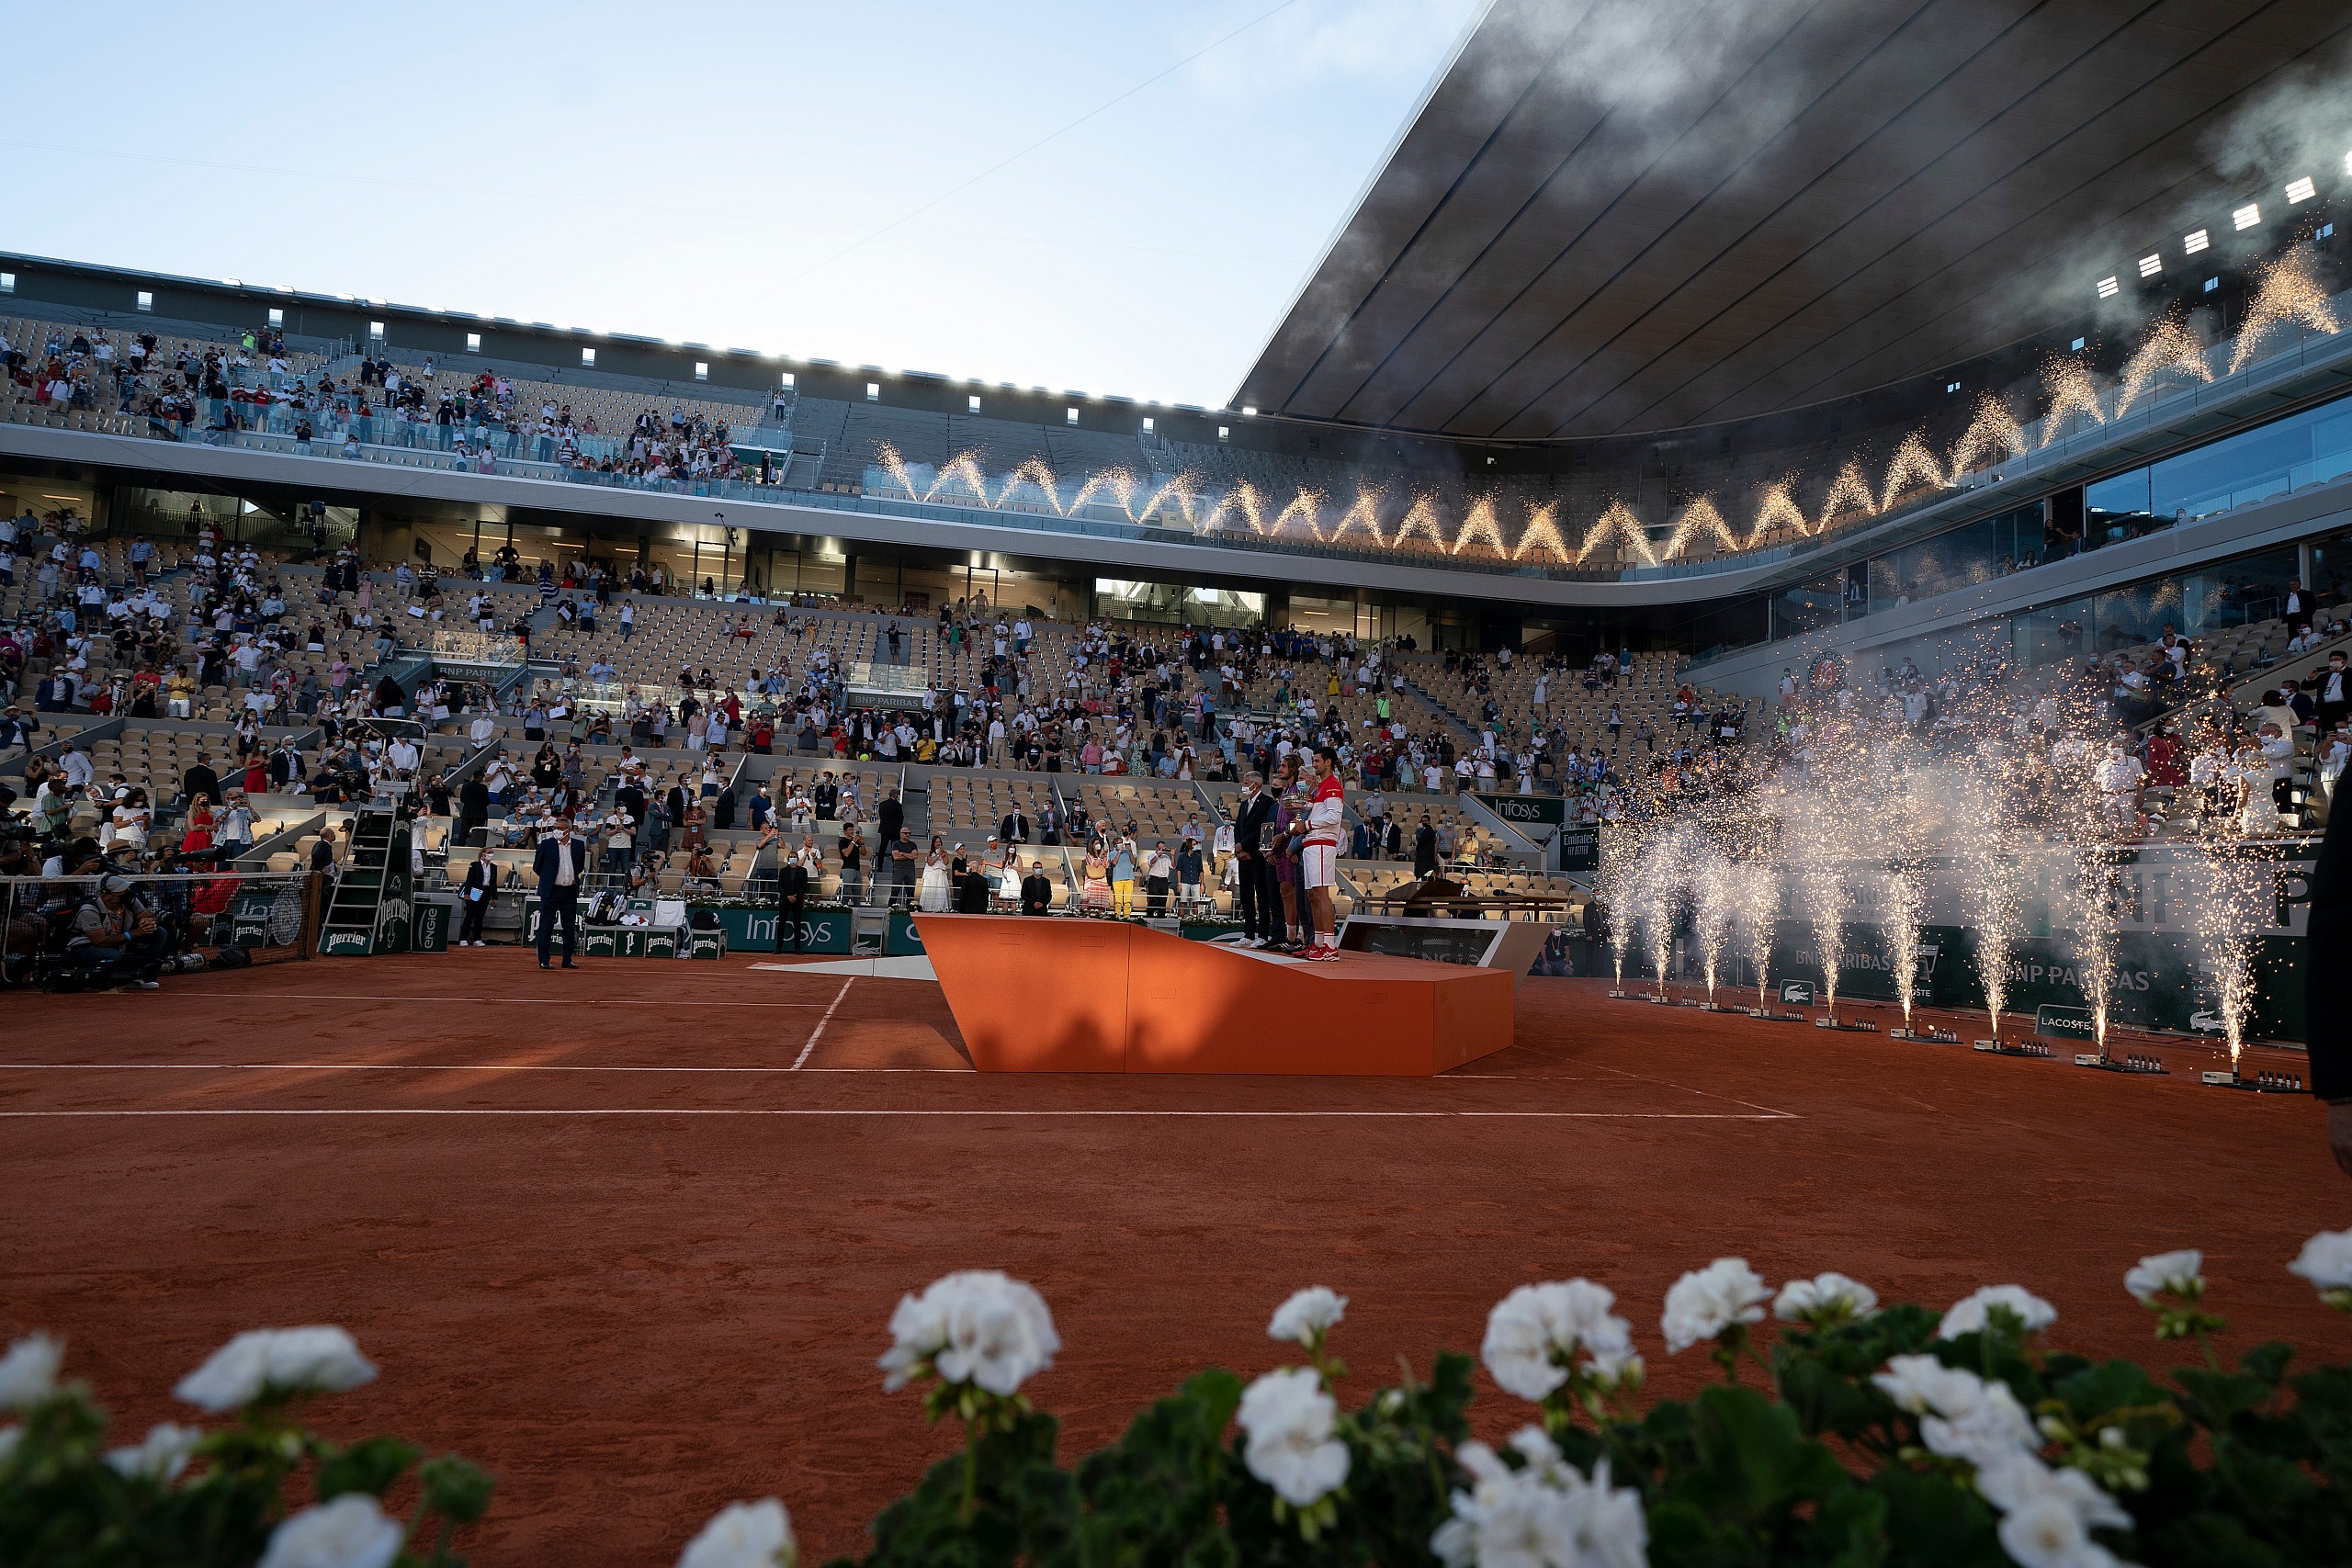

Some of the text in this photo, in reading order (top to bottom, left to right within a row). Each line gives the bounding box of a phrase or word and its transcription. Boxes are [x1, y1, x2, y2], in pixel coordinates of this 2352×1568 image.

[855, 695, 918, 707] BNP PARIBAS
[1495, 798, 1541, 820] Infosys
[1564, 833, 1593, 846] Emirates
[379, 897, 410, 942] perrier
[234, 924, 264, 942] perrier
[326, 931, 367, 953] perrier
[586, 933, 614, 952] perrier
[647, 935, 673, 953] perrier
[692, 938, 718, 954] perrier
[1833, 952, 1891, 971] ARIBAS
[2041, 1017, 2090, 1031] LACOSTE
